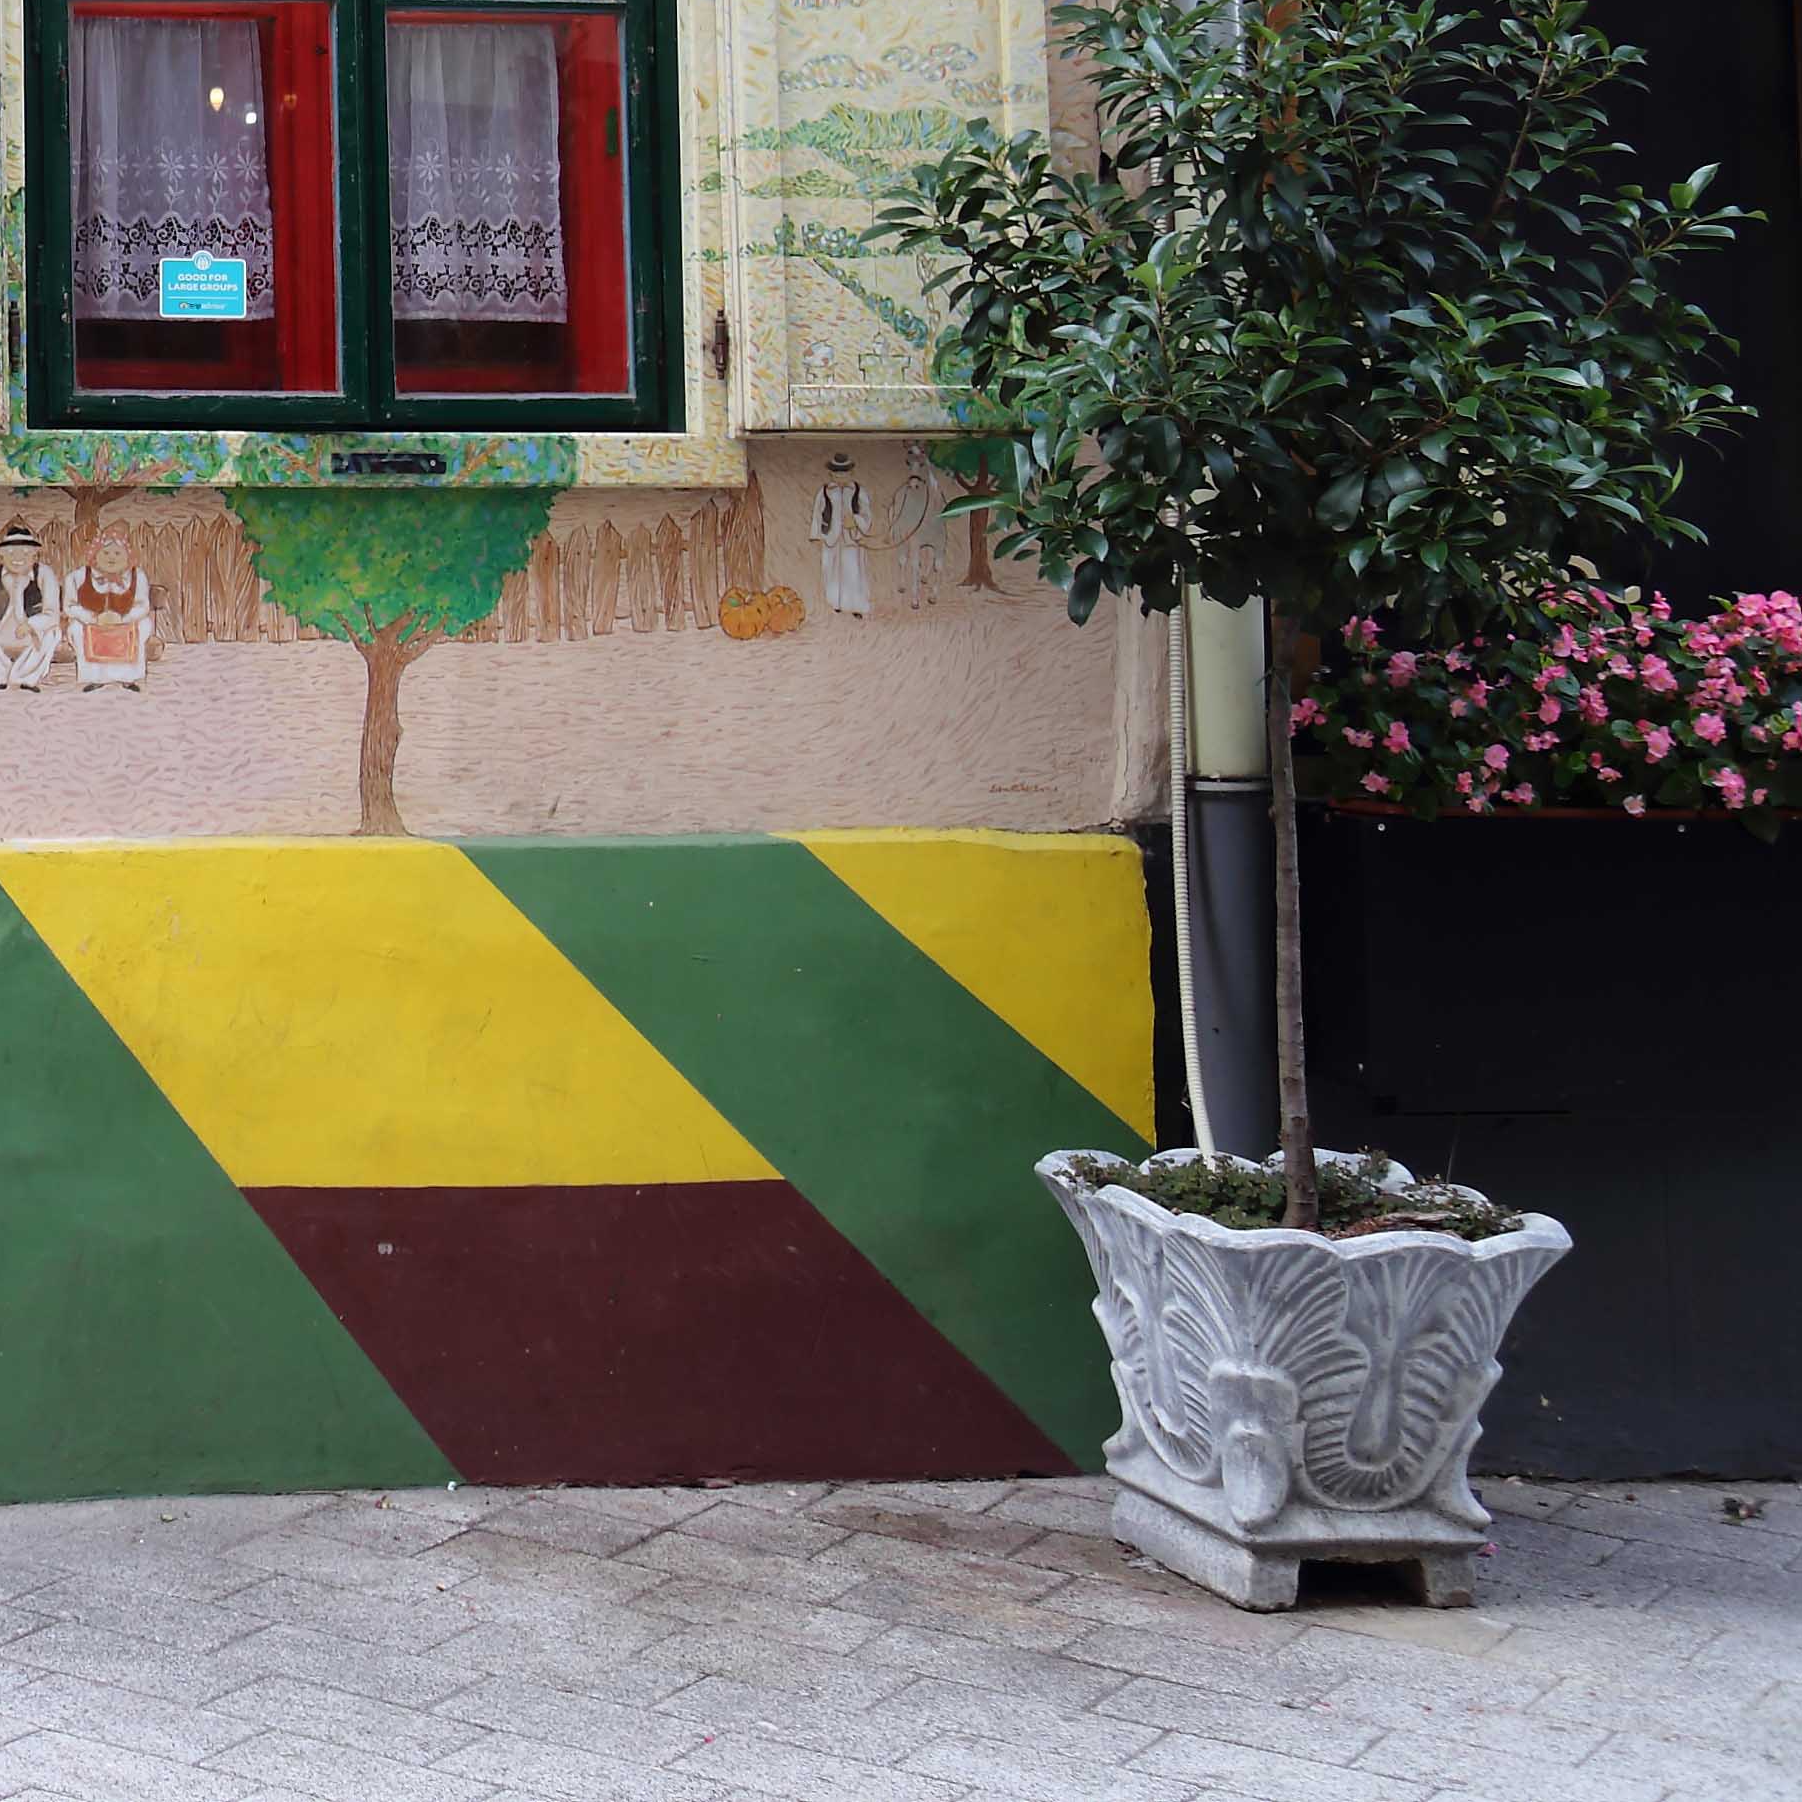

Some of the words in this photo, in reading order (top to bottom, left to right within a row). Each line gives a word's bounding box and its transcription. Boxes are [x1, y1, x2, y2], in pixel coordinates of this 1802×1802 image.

[177, 274, 207, 282] GOOD
[208, 274, 228, 282] FOR
[168, 283, 199, 291] LARGE
[199, 283, 238, 291] GROUPS
